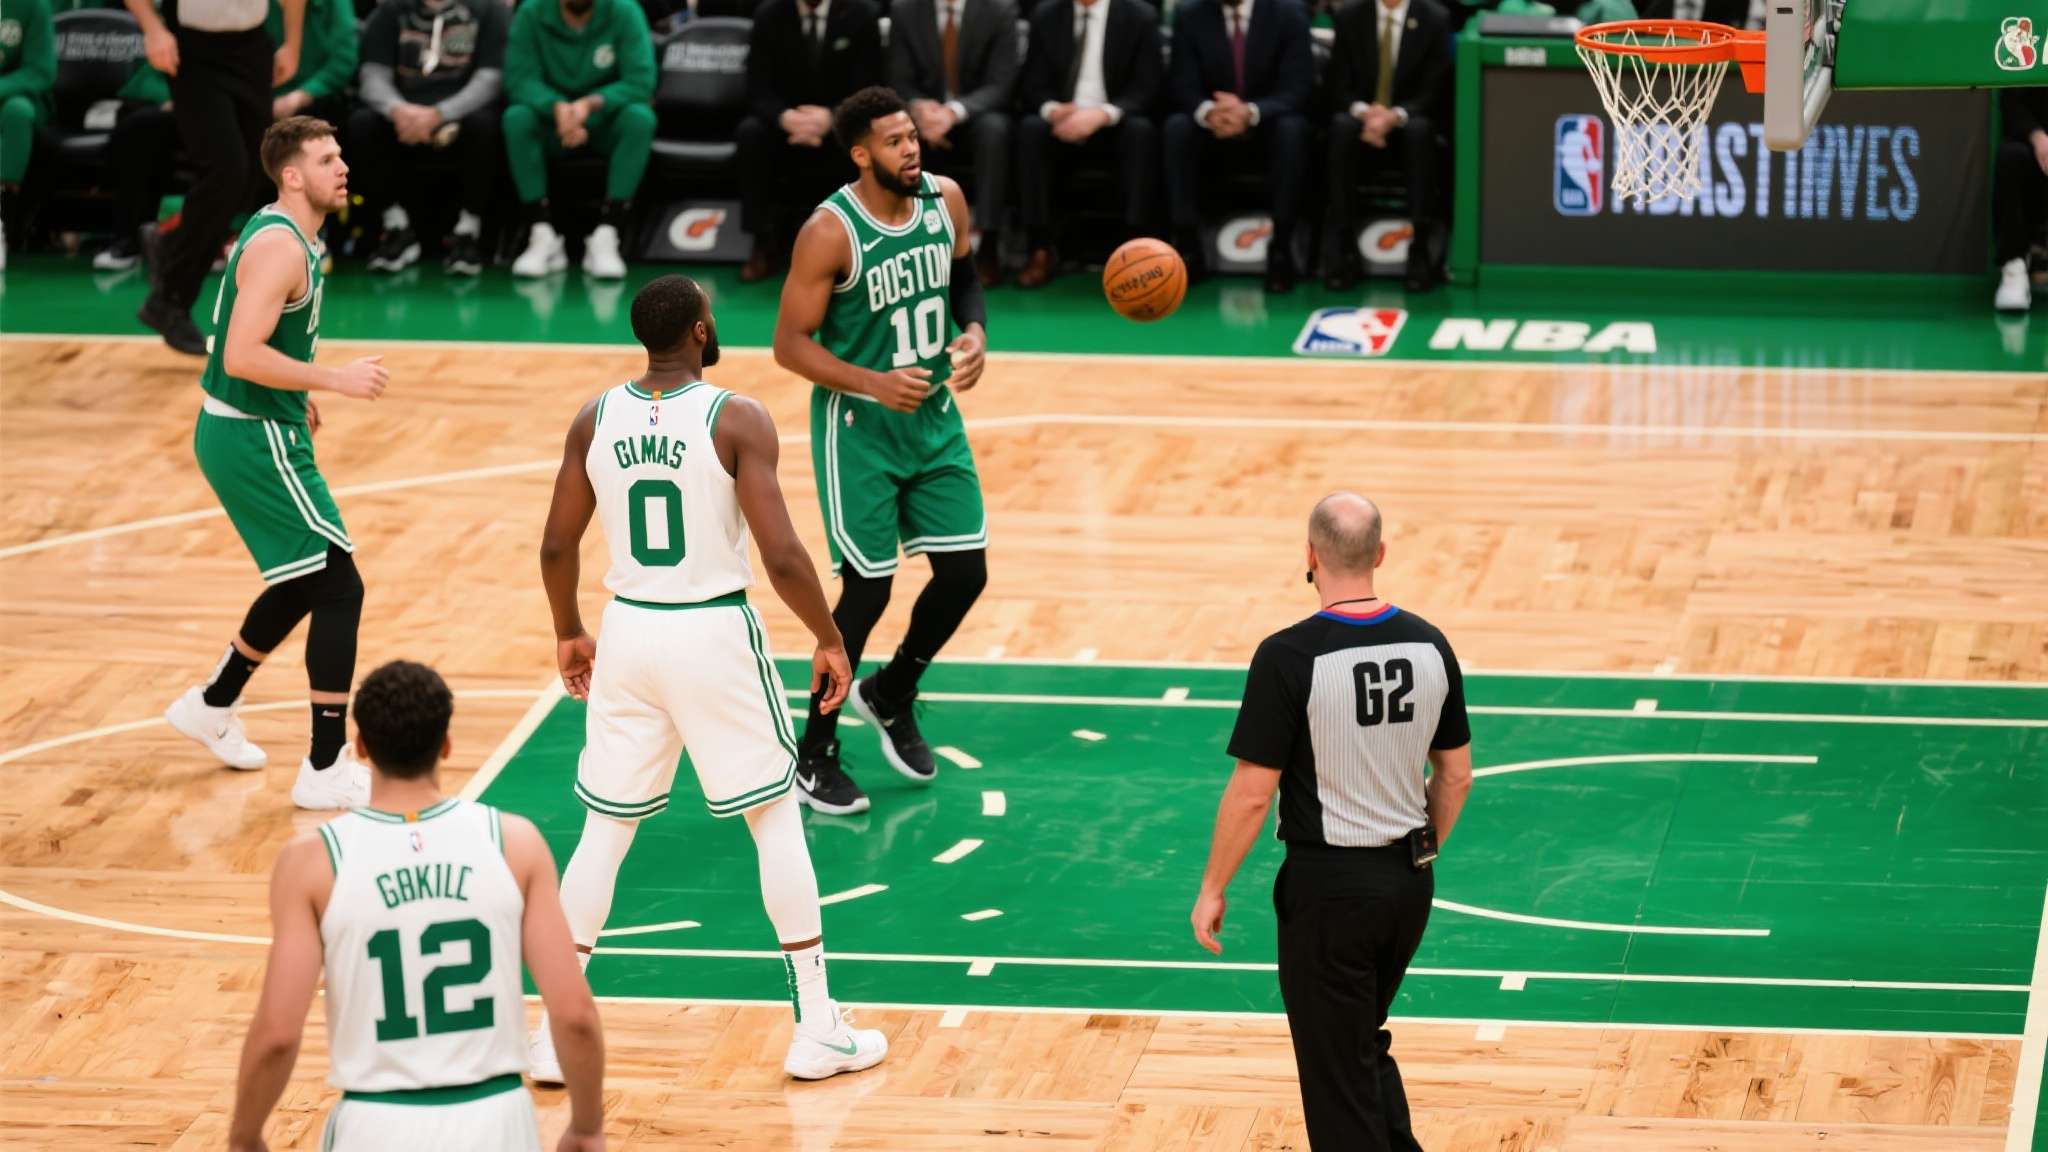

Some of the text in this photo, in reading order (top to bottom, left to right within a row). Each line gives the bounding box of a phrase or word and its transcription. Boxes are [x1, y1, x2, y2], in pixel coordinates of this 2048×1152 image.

[866, 243, 950, 313] BOSTON
[891, 295, 945, 367] 10
[1428, 318, 1656, 353] NBA
[628, 479, 686, 566] 0
[1352, 658, 1415, 727] G2
[367, 918, 495, 1042] 12
